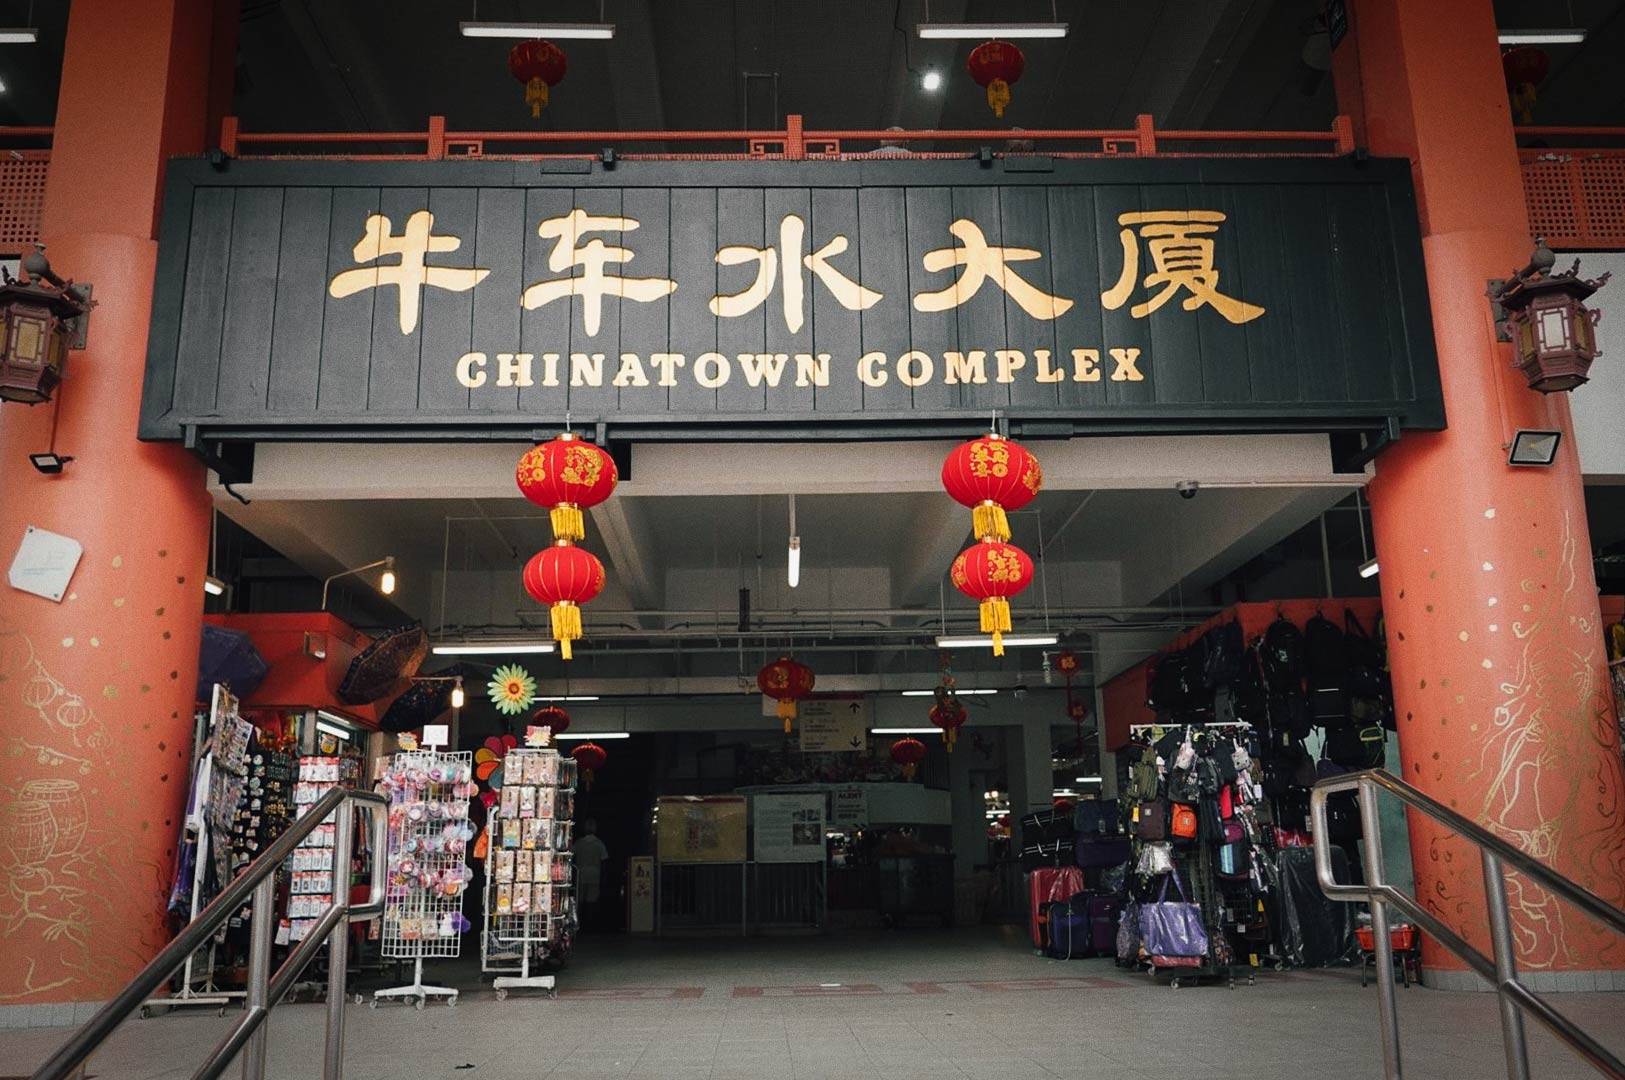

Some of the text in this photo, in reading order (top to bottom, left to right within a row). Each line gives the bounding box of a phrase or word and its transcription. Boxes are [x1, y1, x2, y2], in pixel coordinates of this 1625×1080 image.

[328, 209, 1266, 336] 牛车水大厦
[455, 348, 1144, 393] CHINATOWN COMPLEX
